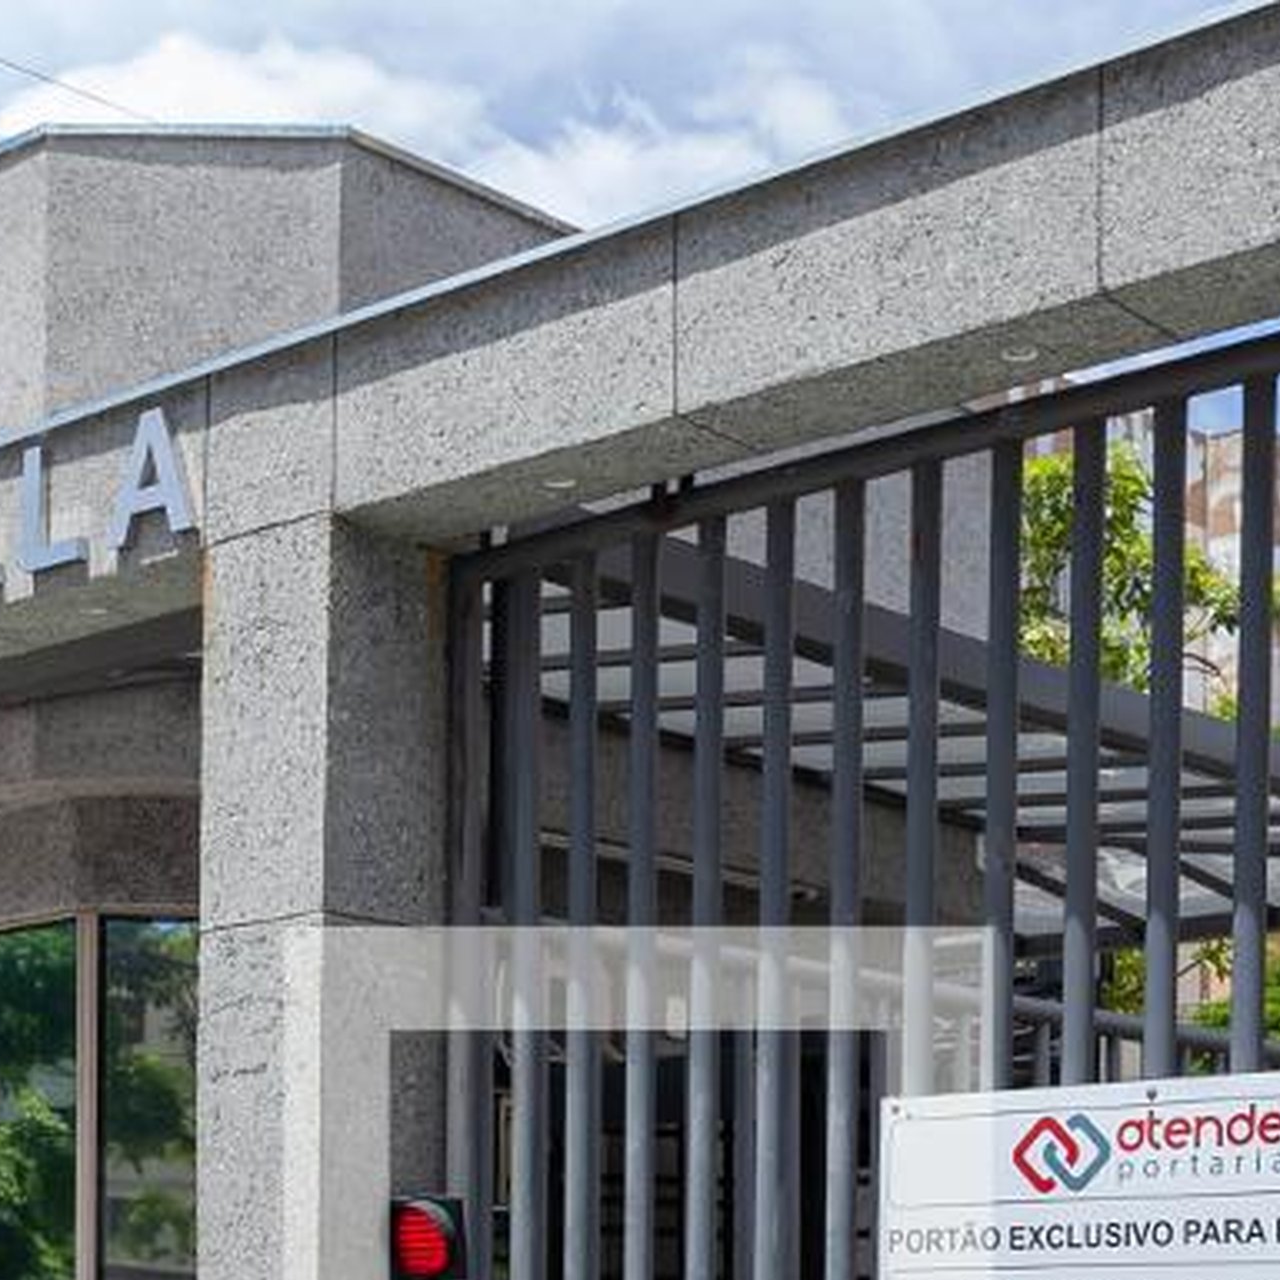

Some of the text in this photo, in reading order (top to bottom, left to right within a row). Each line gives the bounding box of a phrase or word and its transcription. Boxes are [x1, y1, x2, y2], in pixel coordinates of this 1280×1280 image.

[888, 1221, 1001, 1254] PORTÃO
[1009, 1220, 1174, 1250] EXCLUSIVO
[1183, 1218, 1267, 1246] PARA
